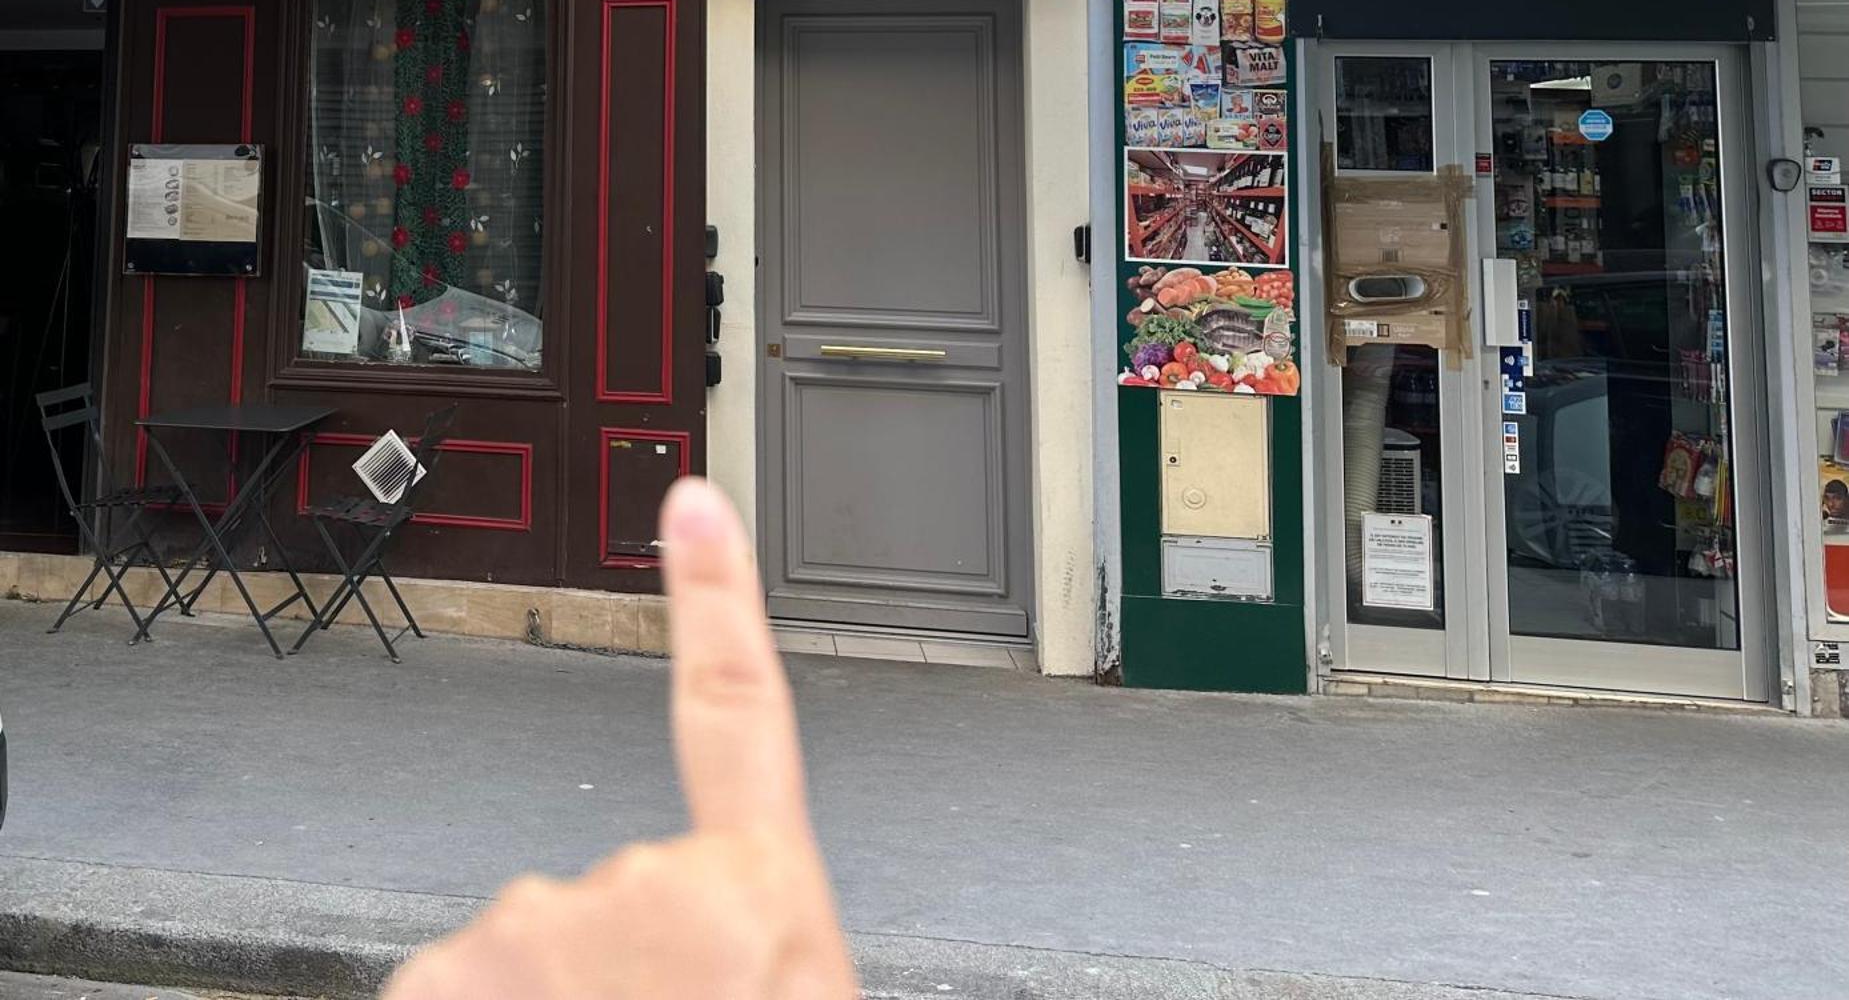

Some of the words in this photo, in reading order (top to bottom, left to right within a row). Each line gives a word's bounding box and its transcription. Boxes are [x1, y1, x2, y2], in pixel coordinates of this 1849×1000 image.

[1249, 51, 1275, 62] VITA
[1249, 61, 1279, 72] MALT
[1811, 188, 1842, 196] SECTOR
